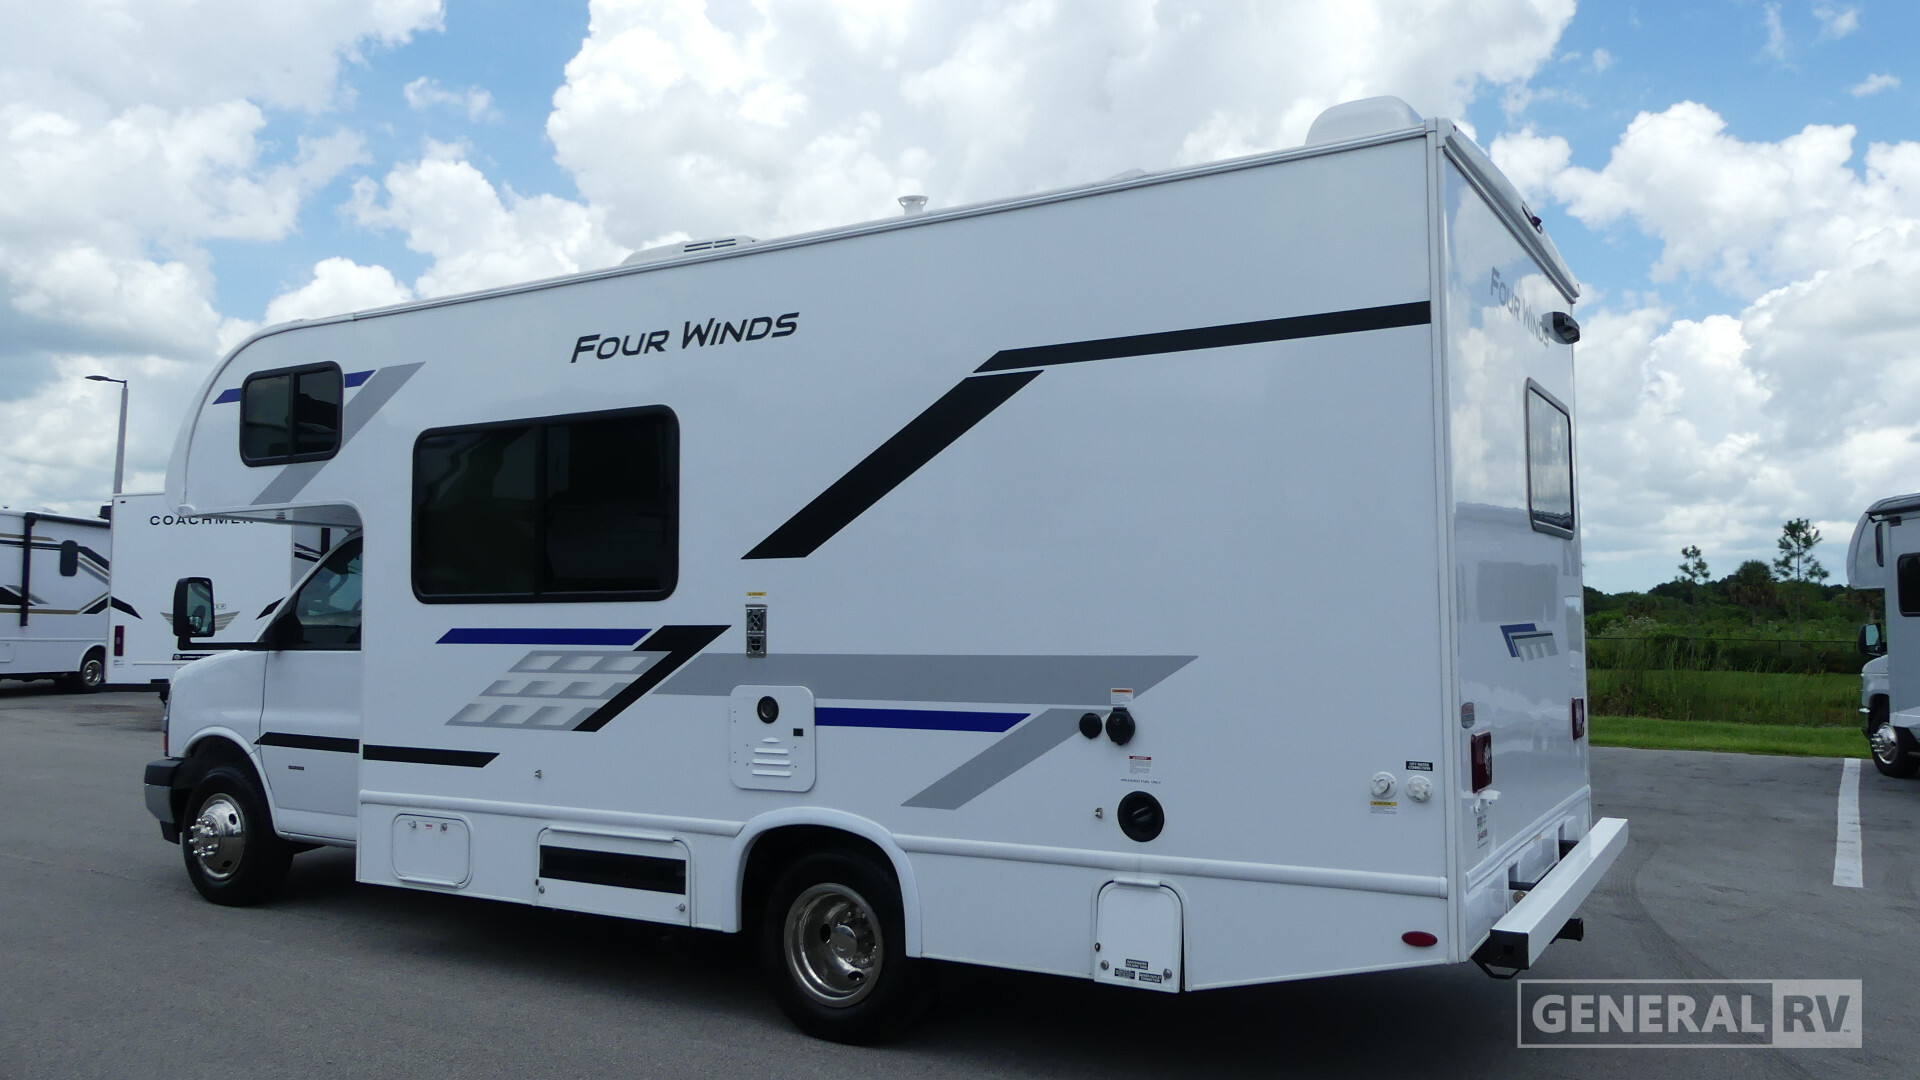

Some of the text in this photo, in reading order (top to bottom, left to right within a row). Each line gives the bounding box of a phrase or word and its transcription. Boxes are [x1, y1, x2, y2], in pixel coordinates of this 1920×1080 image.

[1490, 266, 1520, 321] FOUR
[570, 312, 800, 364] FOUR WINDS
